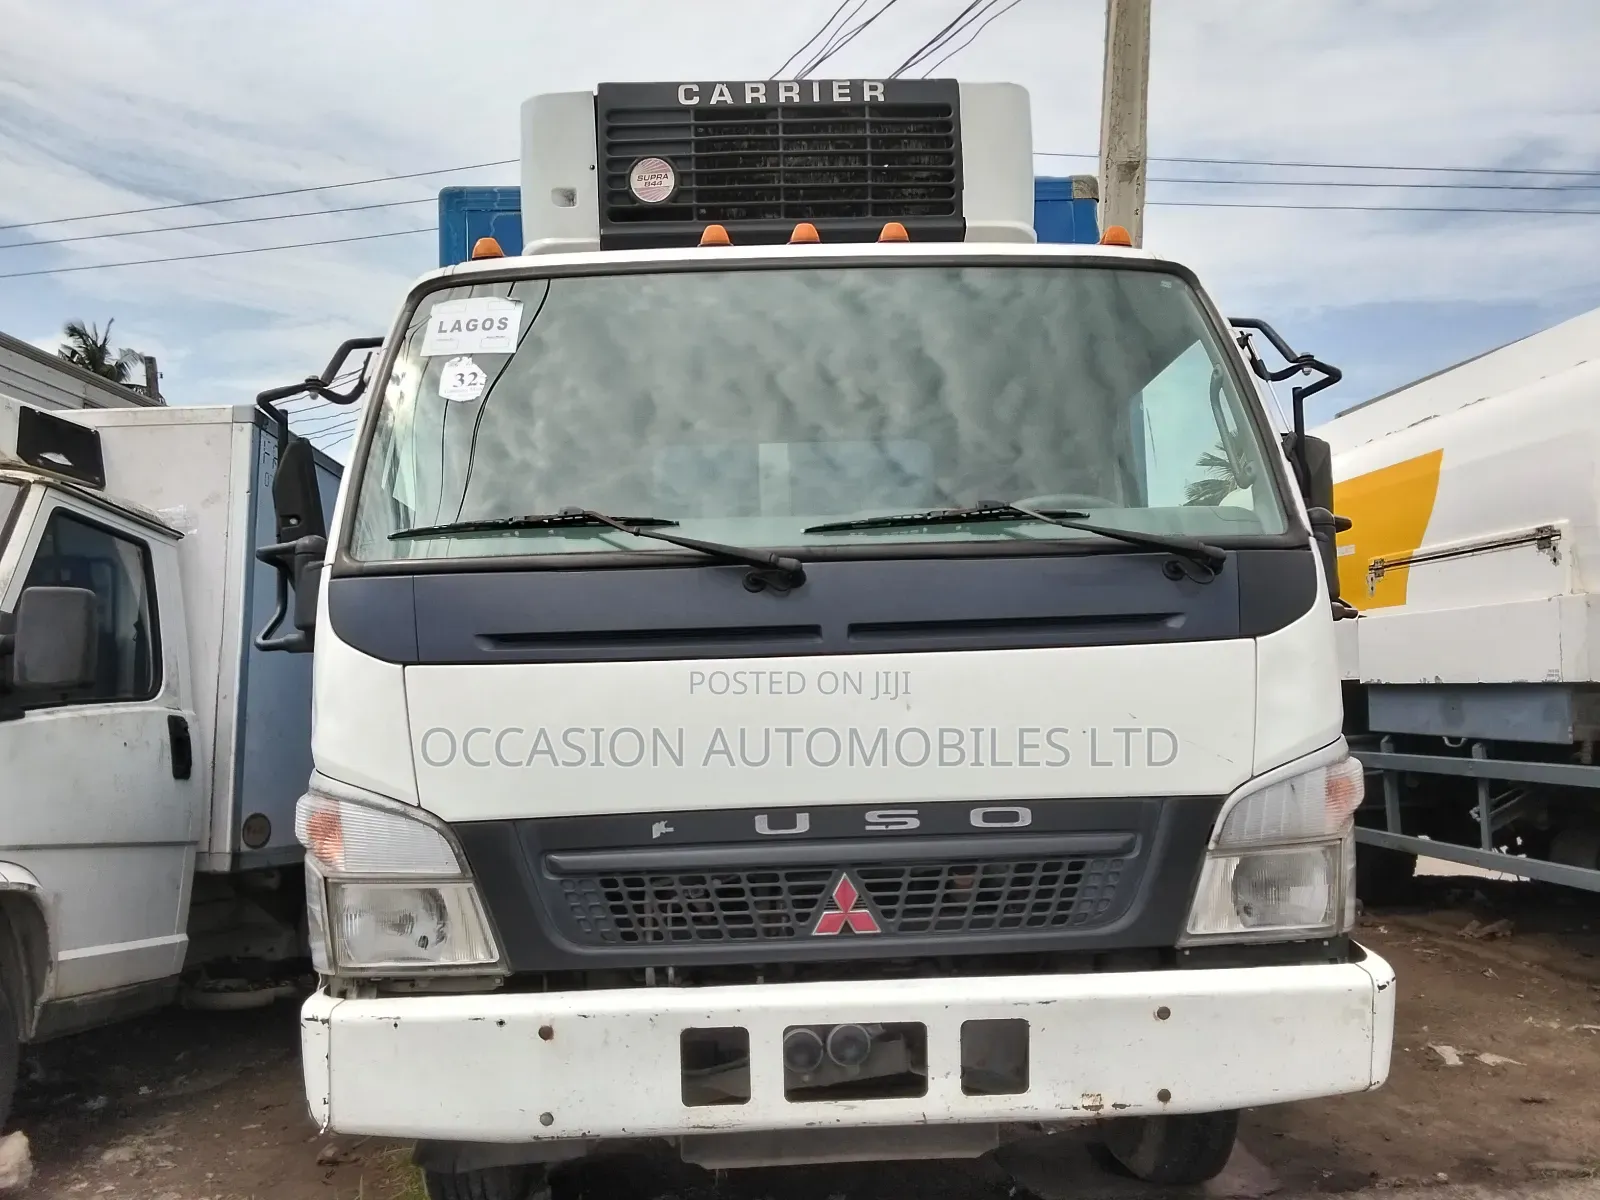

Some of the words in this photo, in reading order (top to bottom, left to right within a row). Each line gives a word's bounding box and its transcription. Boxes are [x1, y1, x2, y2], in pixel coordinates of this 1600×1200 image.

[677, 80, 886, 106] CARRIER
[636, 173, 669, 182] SUPRA
[437, 316, 509, 334] LAGOS
